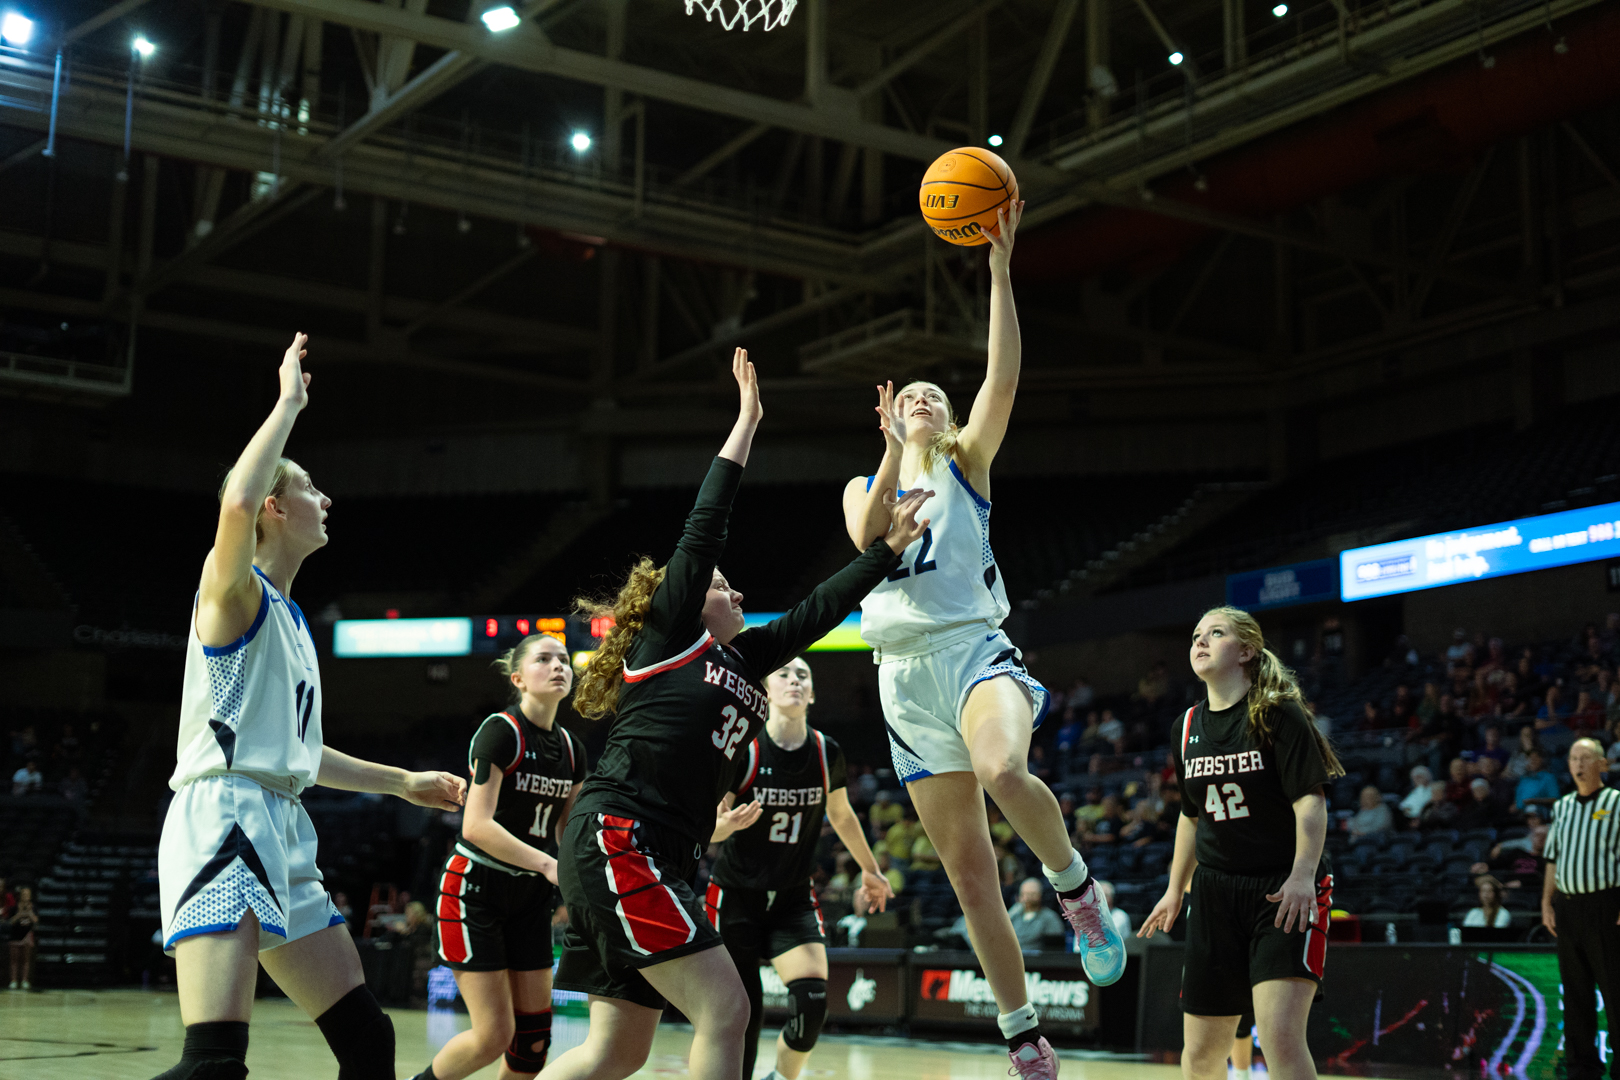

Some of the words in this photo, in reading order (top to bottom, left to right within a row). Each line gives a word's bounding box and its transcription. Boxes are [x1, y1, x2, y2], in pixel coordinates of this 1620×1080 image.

[926, 194, 959, 209] EVO
[295, 679, 315, 744] 11
[711, 704, 750, 761] 32
[1184, 750, 1265, 780] WEBSTER
[752, 786, 823, 806] WEBSTER
[1204, 782, 1250, 822] 42
[528, 802, 553, 839] 11
[768, 811, 803, 844] 21
